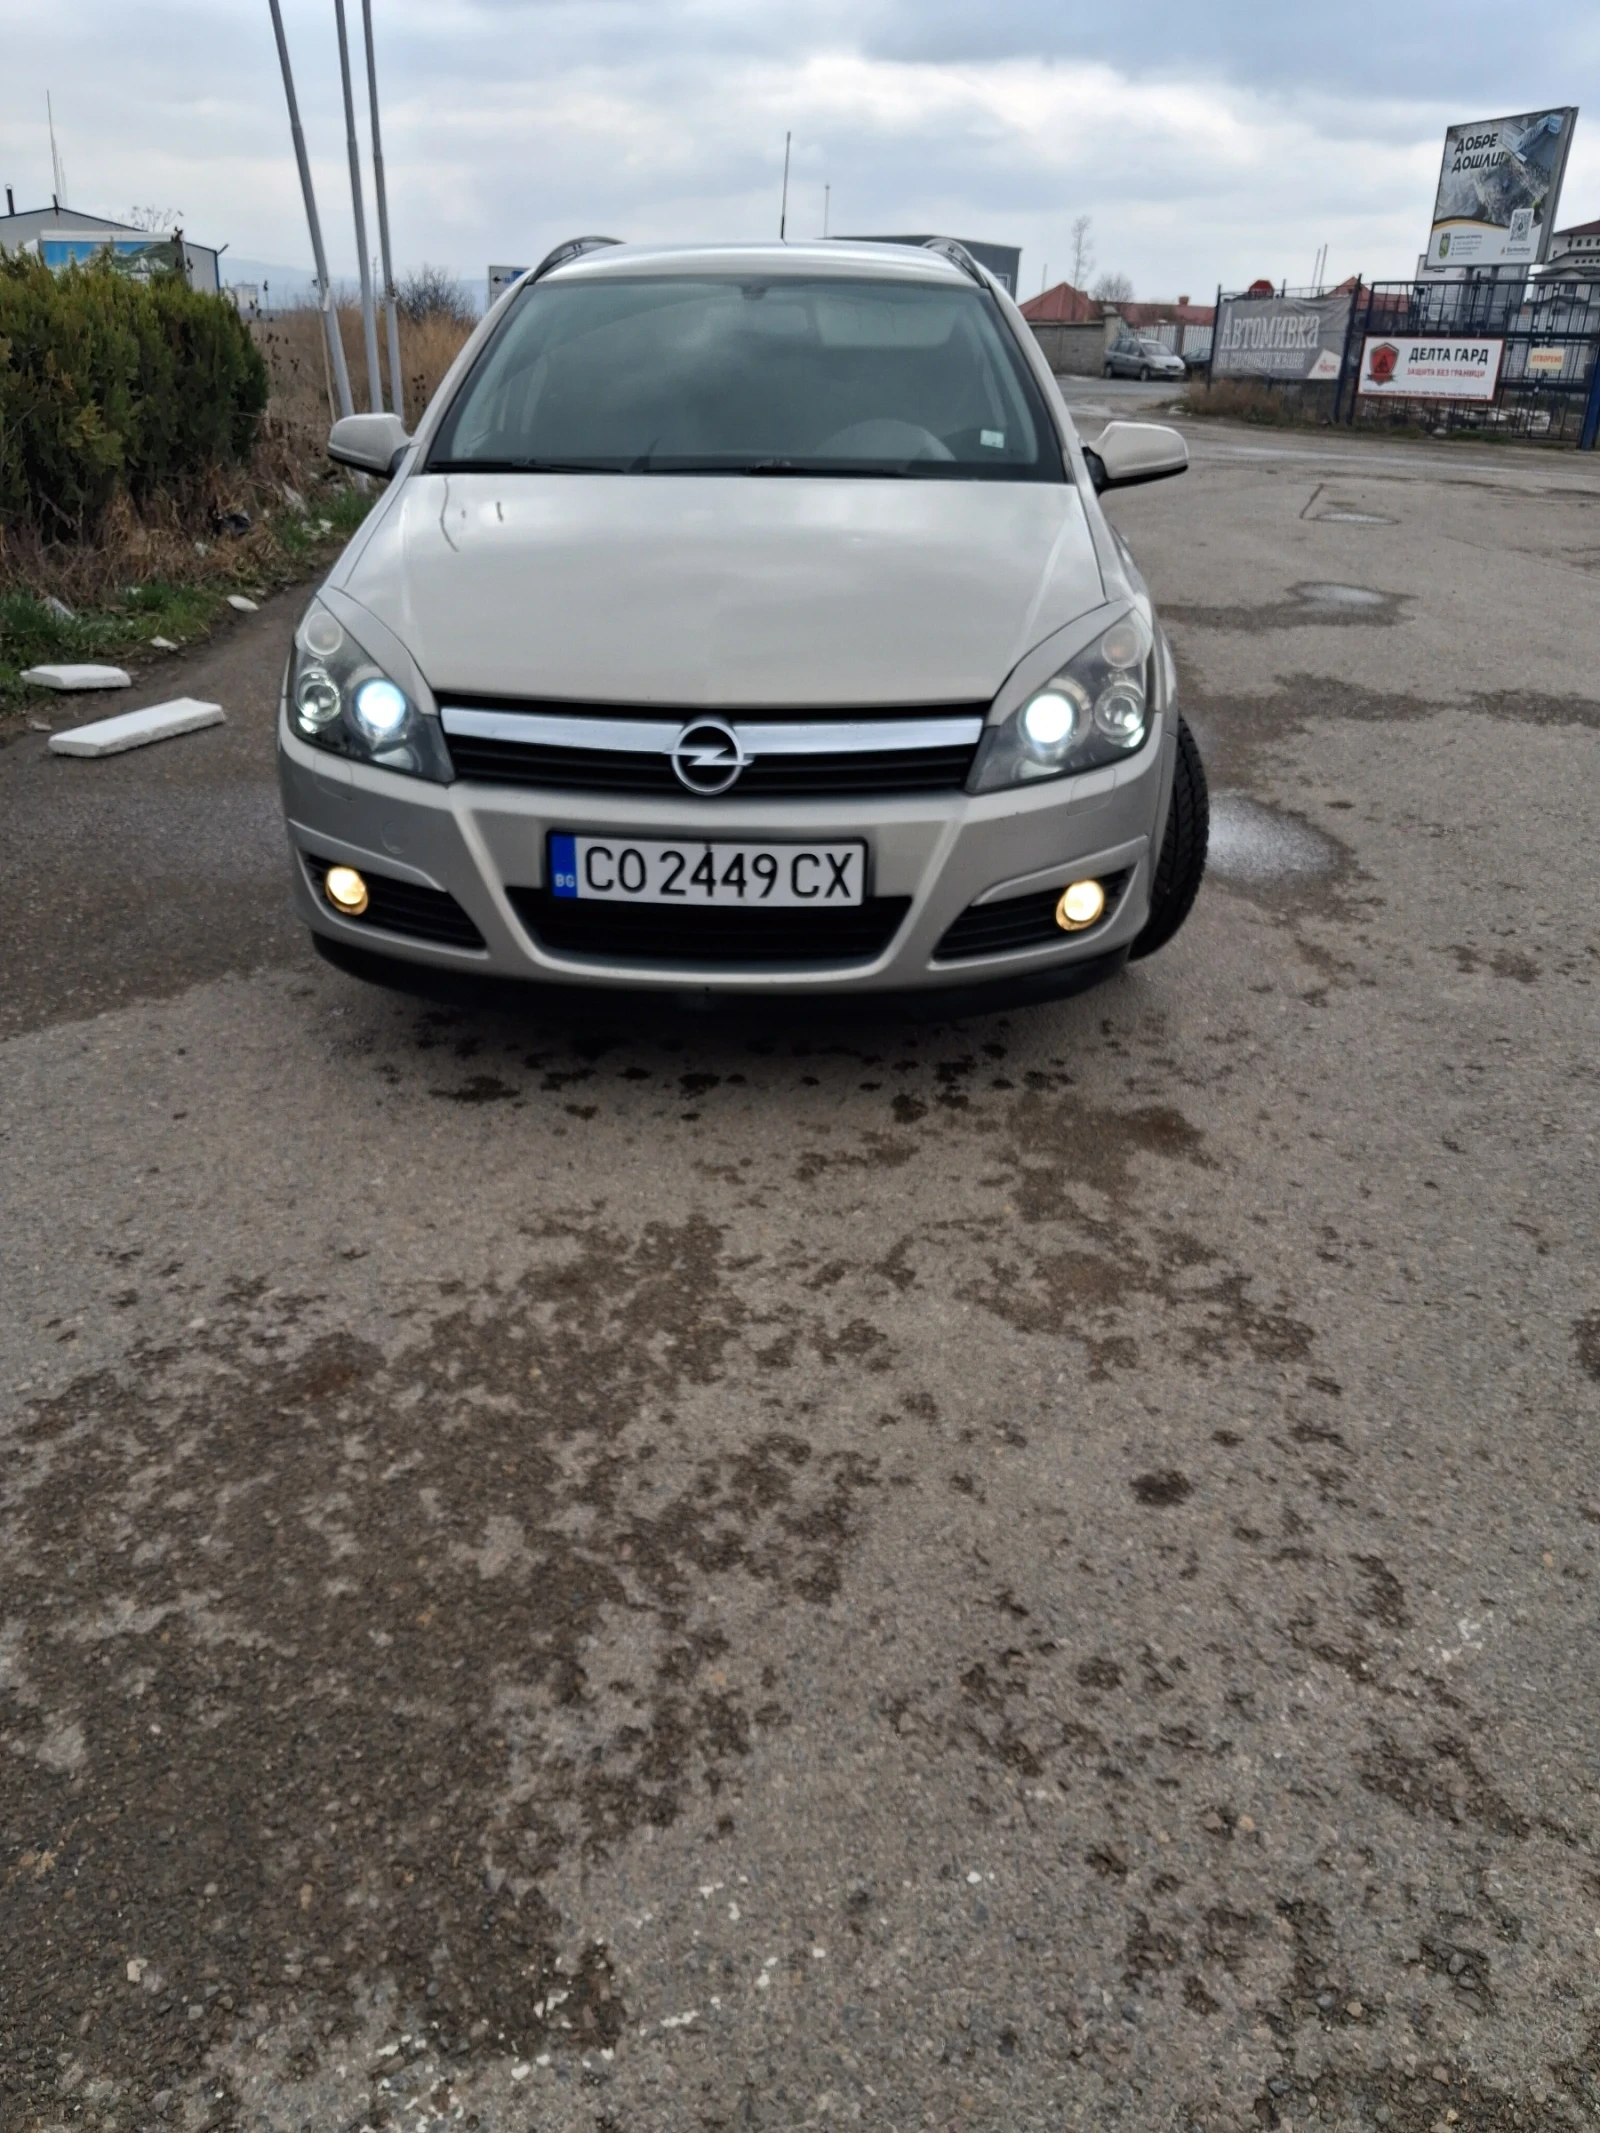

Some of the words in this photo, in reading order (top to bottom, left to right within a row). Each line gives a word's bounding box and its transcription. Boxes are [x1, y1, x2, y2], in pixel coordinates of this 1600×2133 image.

[1454, 133, 1498, 154] ДОБРЕ
[1451, 152, 1504, 174] ДОШЛИ!
[1409, 347, 1451, 364] ДЕЛТА
[1454, 348, 1489, 366] ГАРД
[555, 874, 575, 887] BG
